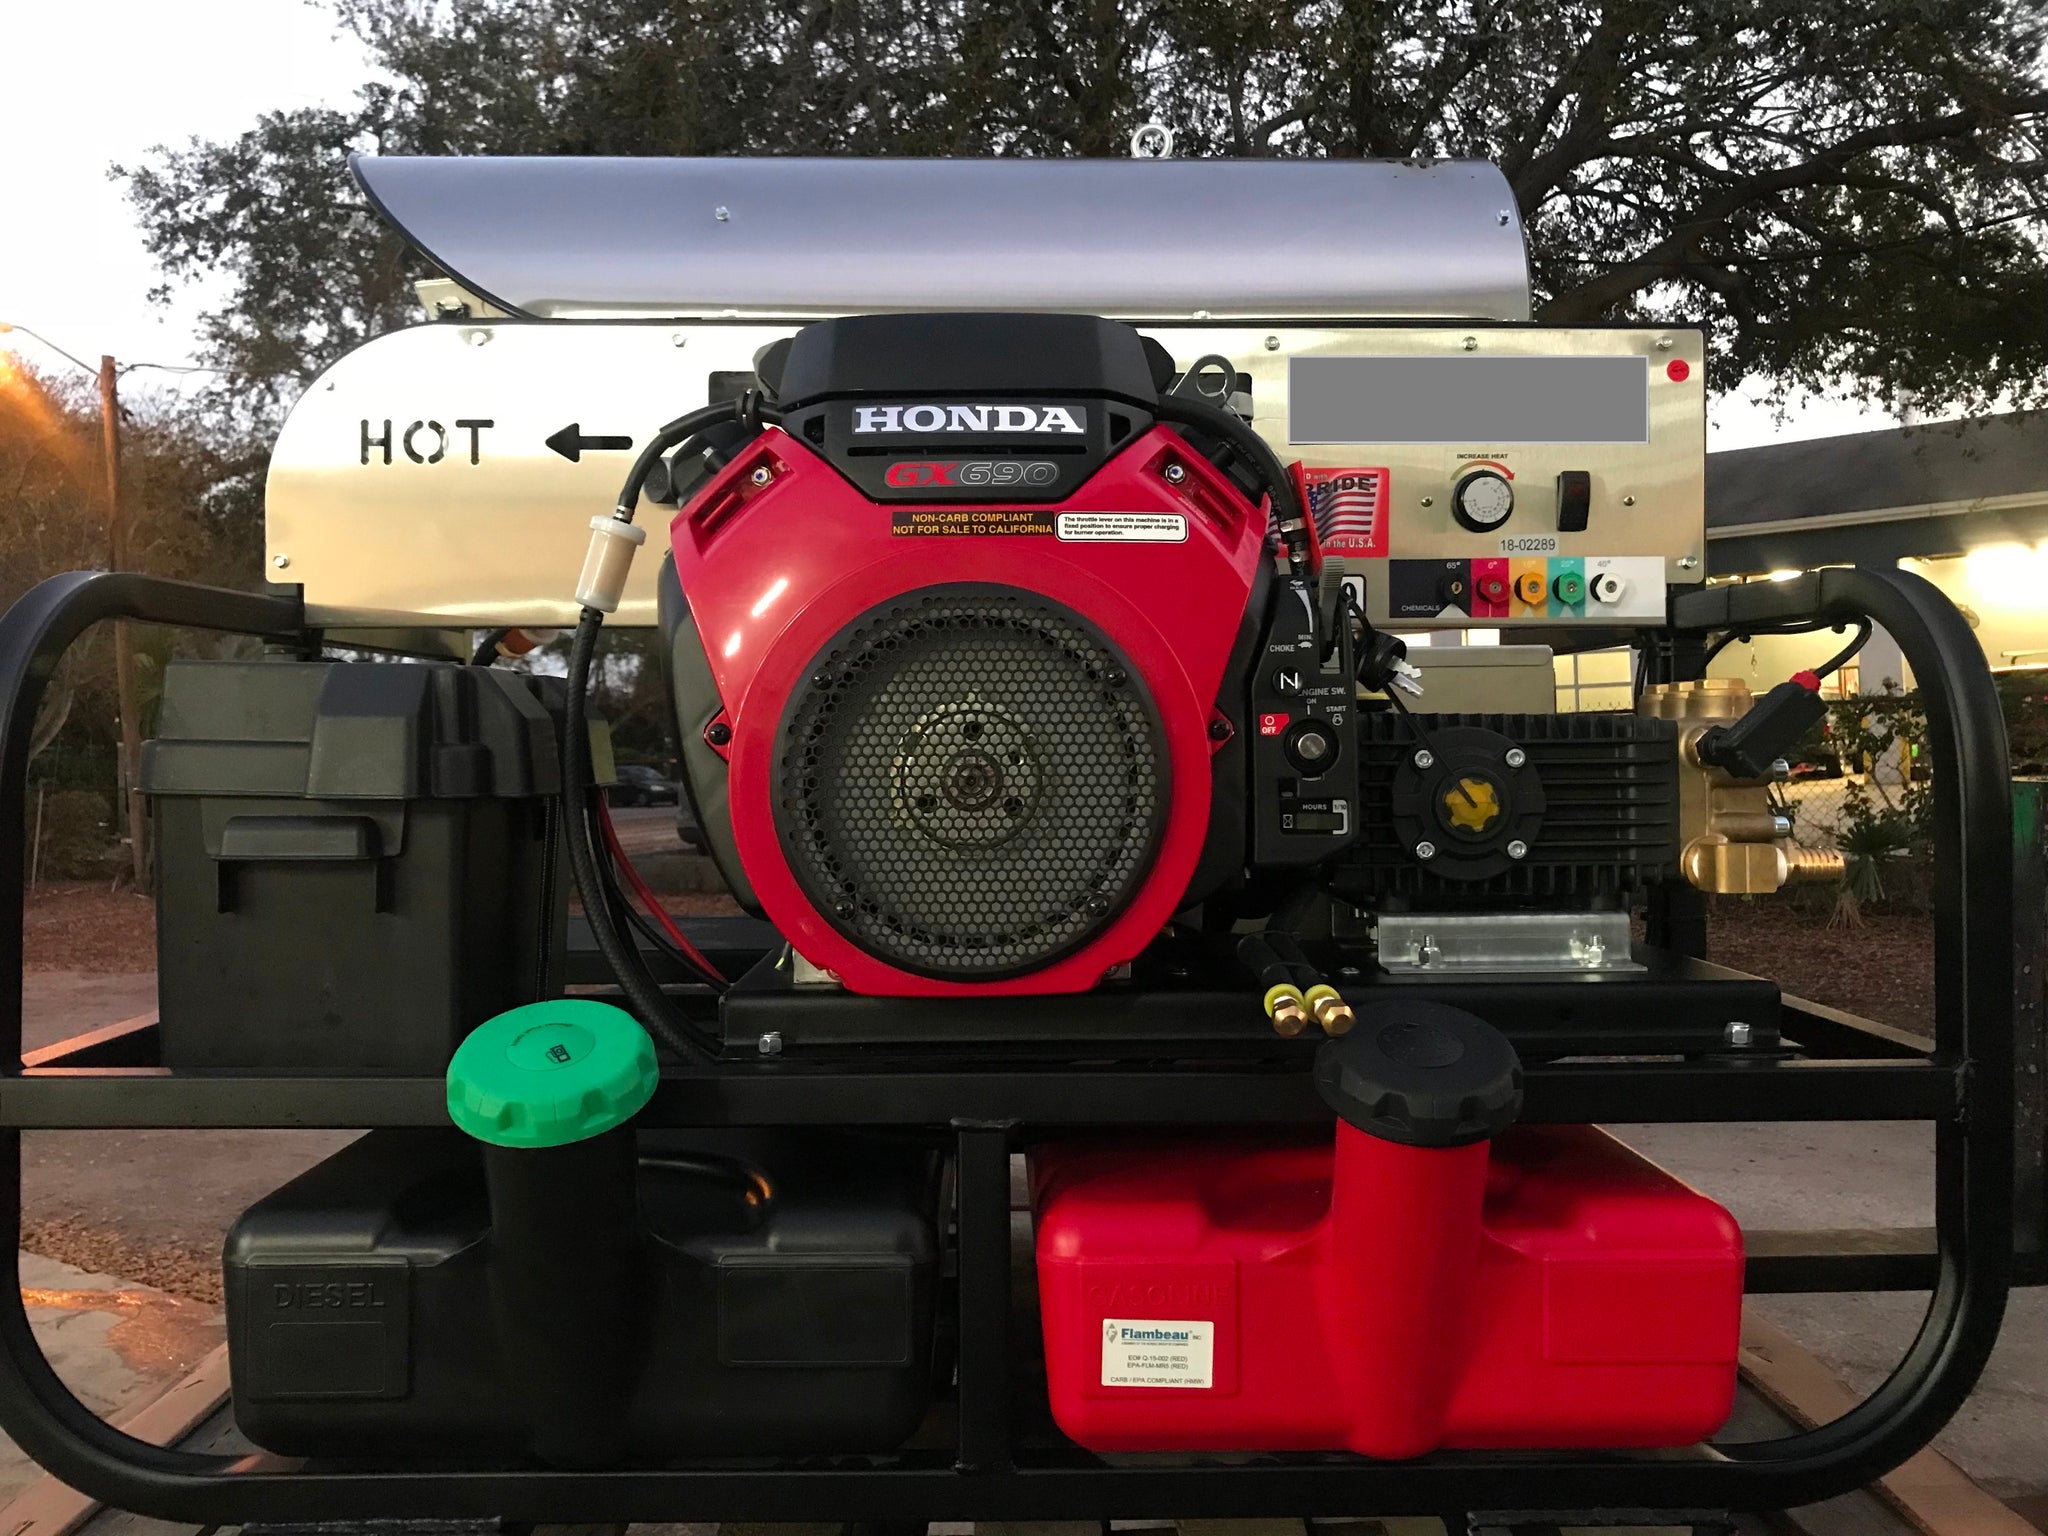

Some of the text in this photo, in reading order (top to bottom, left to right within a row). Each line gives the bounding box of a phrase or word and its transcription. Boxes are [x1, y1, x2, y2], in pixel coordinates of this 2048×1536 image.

[855, 406, 1084, 433] HONDA
[361, 419, 494, 465] HOT
[912, 513, 1033, 522] NON-CARB COMPLIANT
[893, 525, 1053, 534] NOT FOR SALE TO CALIFORNIA
[1333, 539, 1346, 548] the
[1348, 538, 1376, 548] U.S.A.
[1500, 539, 1556, 551] 18-02289
[1446, 561, 1460, 569] 65°
[1401, 604, 1440, 612] CHEMICALS
[1269, 644, 1295, 652] CHOKE
[1298, 687, 1346, 696] NGINE SW.
[1326, 705, 1347, 713] START
[273, 1283, 386, 1307] DIESEL
[1089, 1284, 1230, 1306] GASOLINE
[1121, 1328, 1189, 1340] Flambeau
